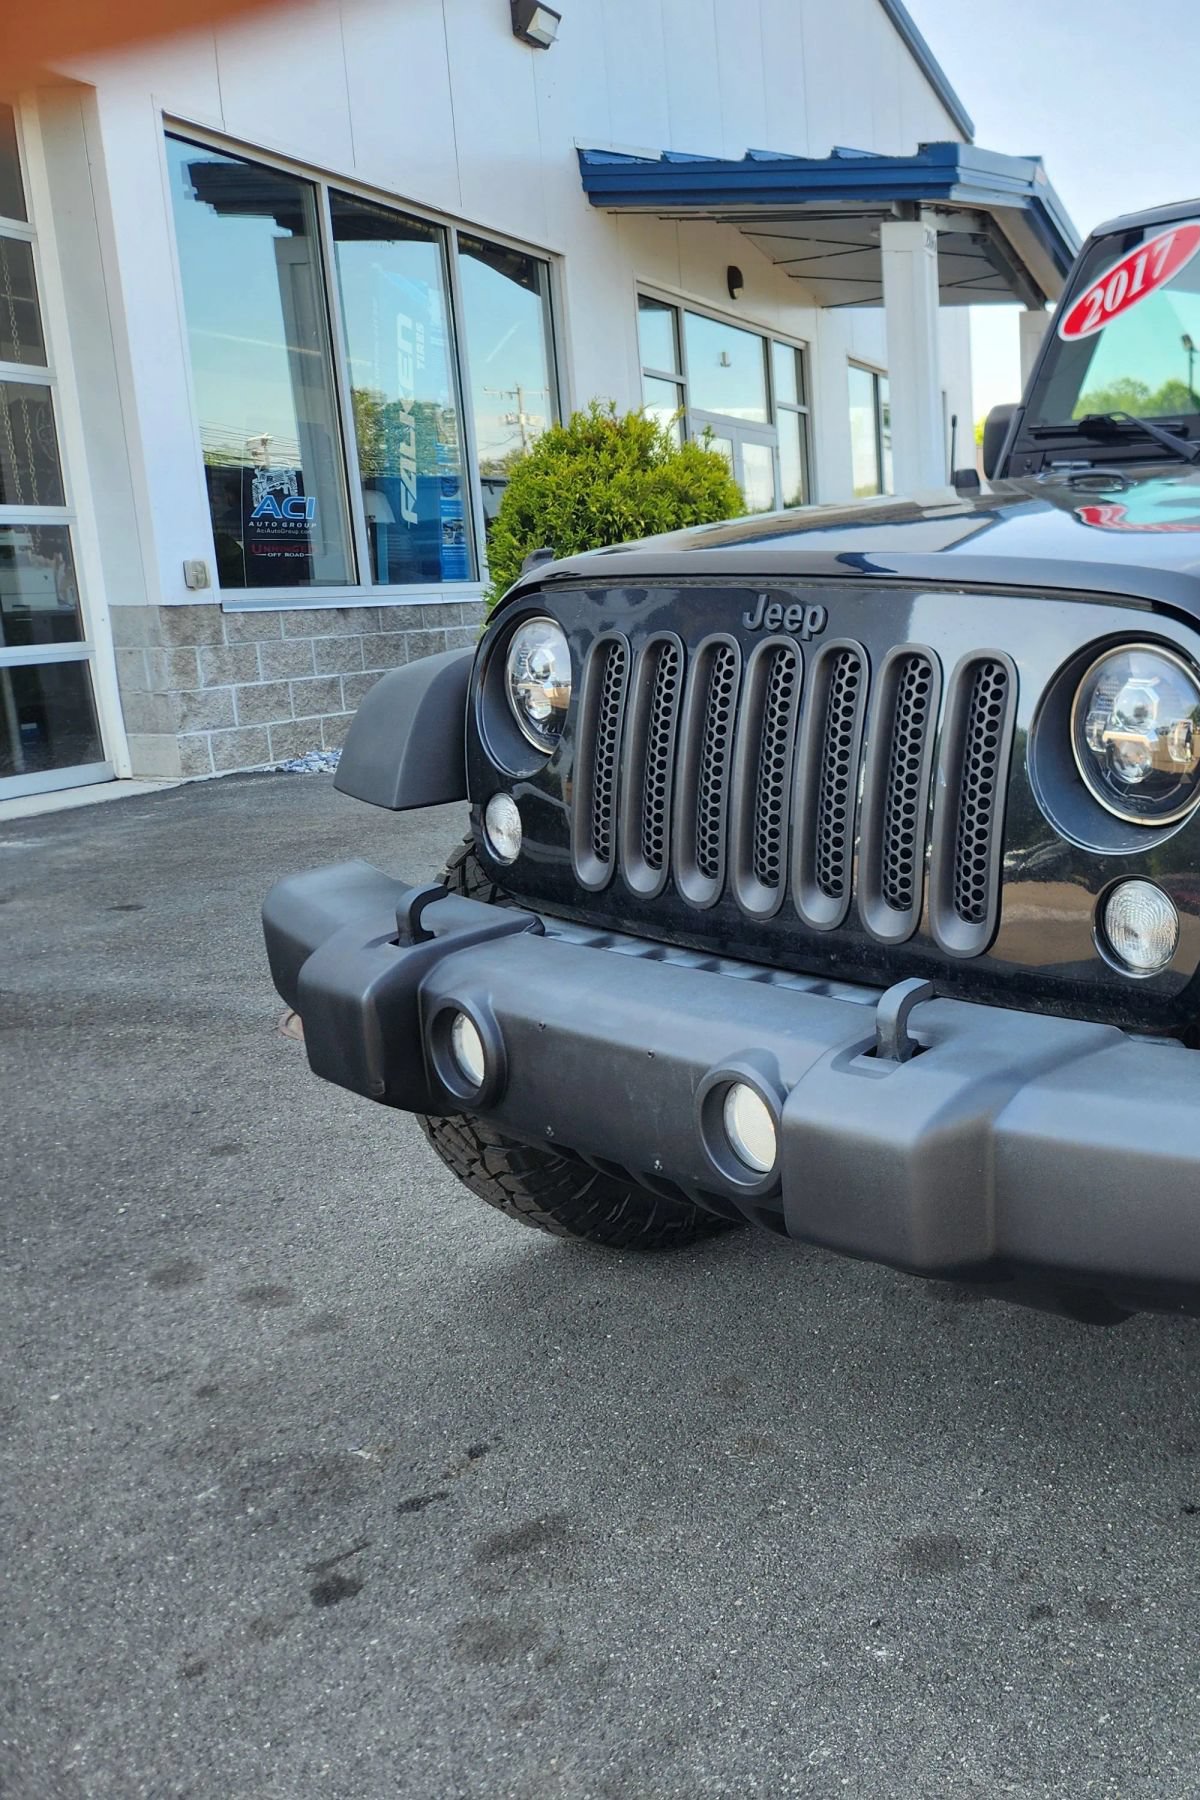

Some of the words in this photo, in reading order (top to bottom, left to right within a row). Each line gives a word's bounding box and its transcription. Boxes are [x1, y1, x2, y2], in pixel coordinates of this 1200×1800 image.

[1080, 233, 1176, 333] 2017
[416, 322, 425, 369] TIRES
[397, 312, 418, 526] FALKEN
[251, 495, 316, 519] ACI
[742, 593, 827, 641] Jeep
